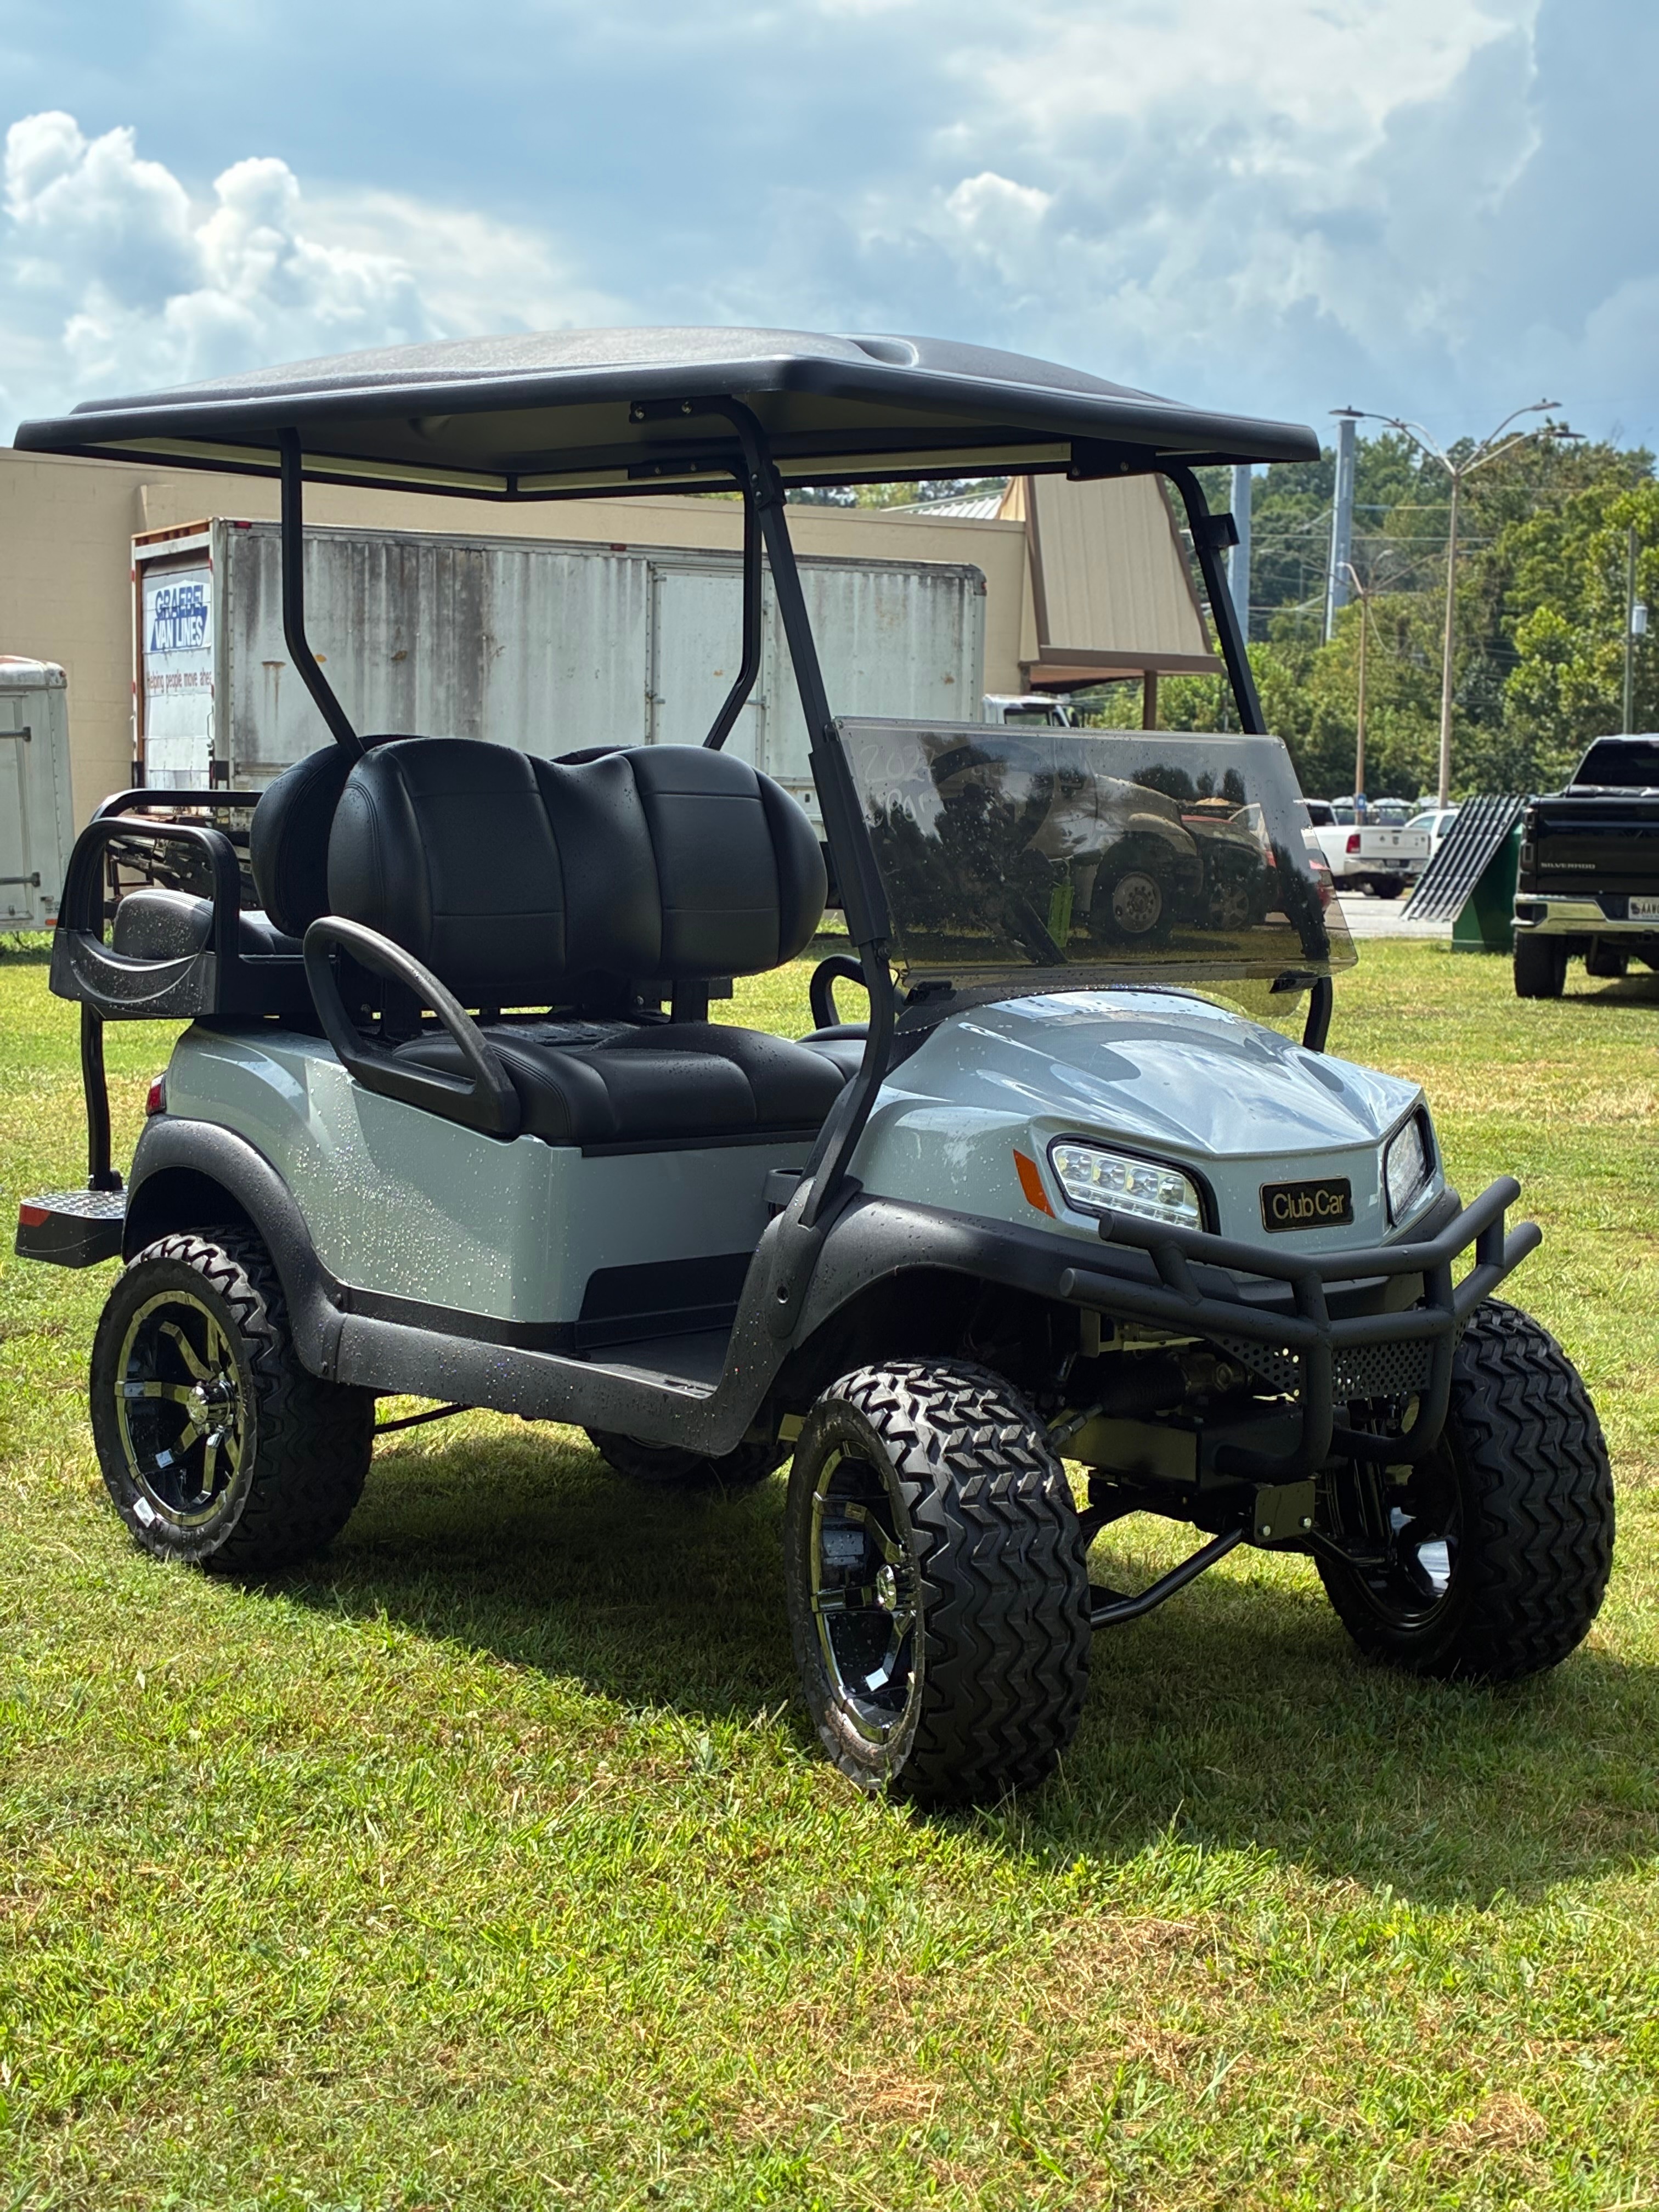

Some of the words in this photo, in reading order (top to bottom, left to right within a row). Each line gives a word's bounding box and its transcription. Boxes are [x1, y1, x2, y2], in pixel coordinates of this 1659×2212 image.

[155, 619, 173, 650] VAN
[176, 616, 203, 647] LINES
[146, 670, 164, 693] Helping
[166, 669, 182, 693] people
[184, 672, 198, 687] move
[1273, 1192, 1314, 1220] Club
[1316, 1189, 1344, 1215] Car
